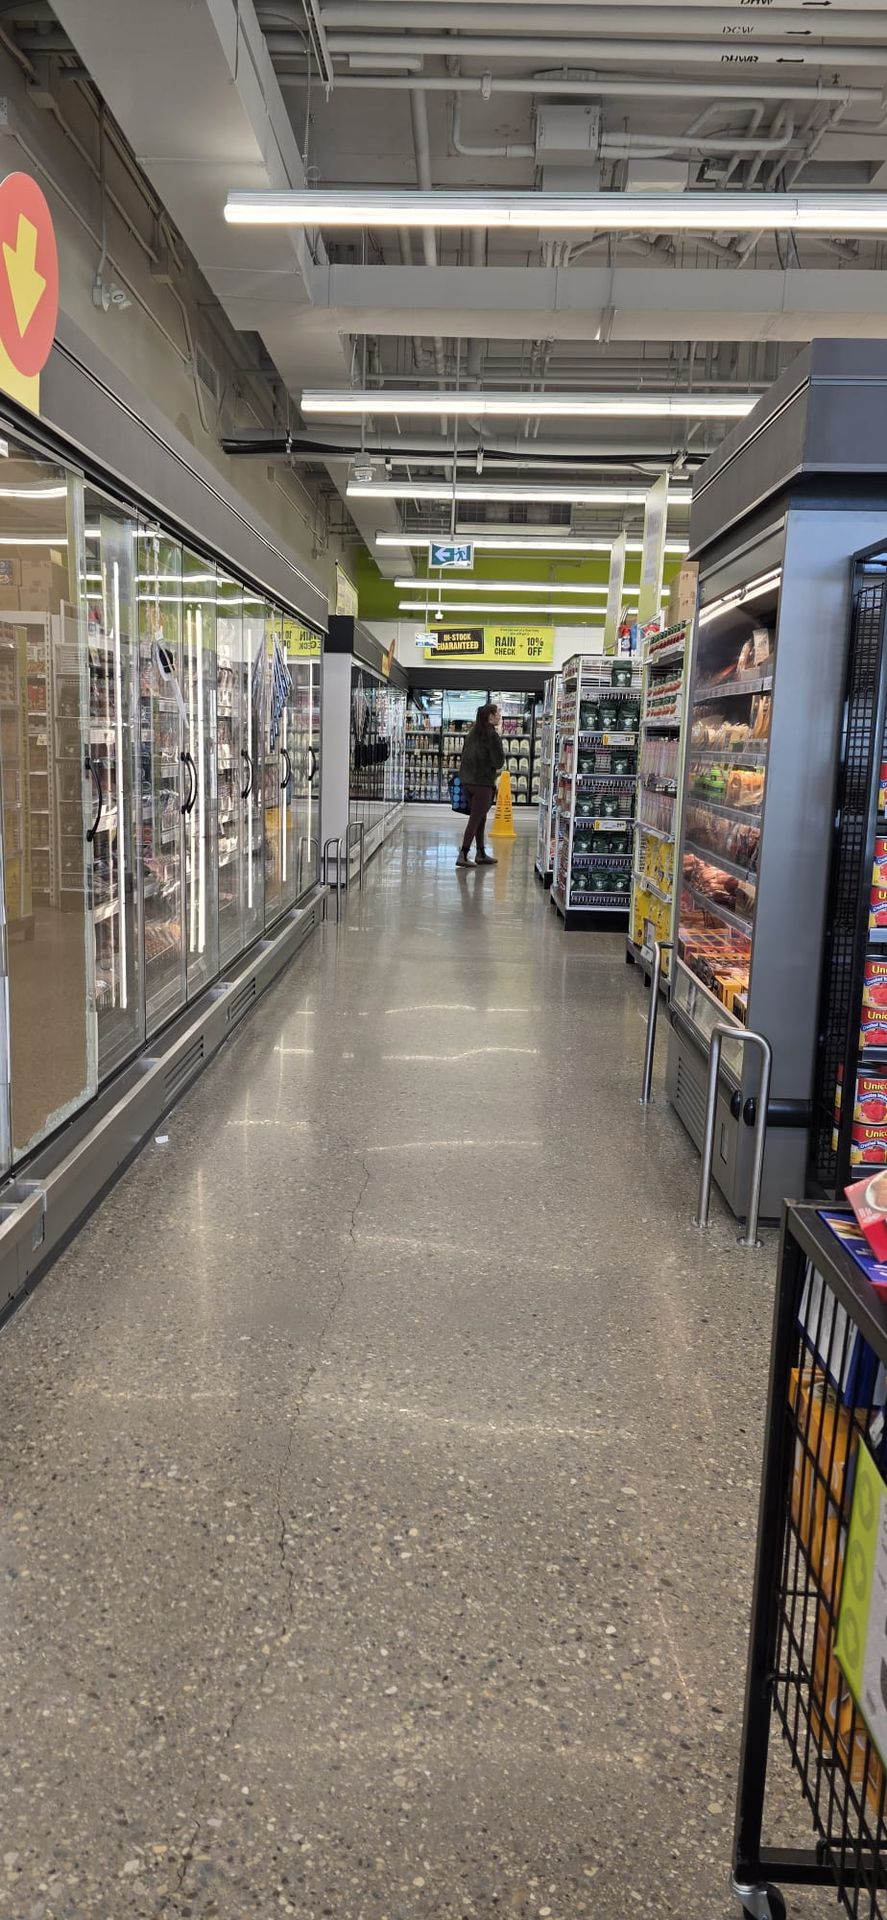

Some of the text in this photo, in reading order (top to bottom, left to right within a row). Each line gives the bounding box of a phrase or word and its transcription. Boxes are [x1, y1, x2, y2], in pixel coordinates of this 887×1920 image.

[443, 633, 471, 641] IN-STOCK
[495, 636, 516, 647] RAIN
[436, 641, 479, 651] GUARANTEED
[527, 637, 544, 647] 10%
[494, 647, 516, 656] CHECK
[527, 647, 543, 656] OFF
